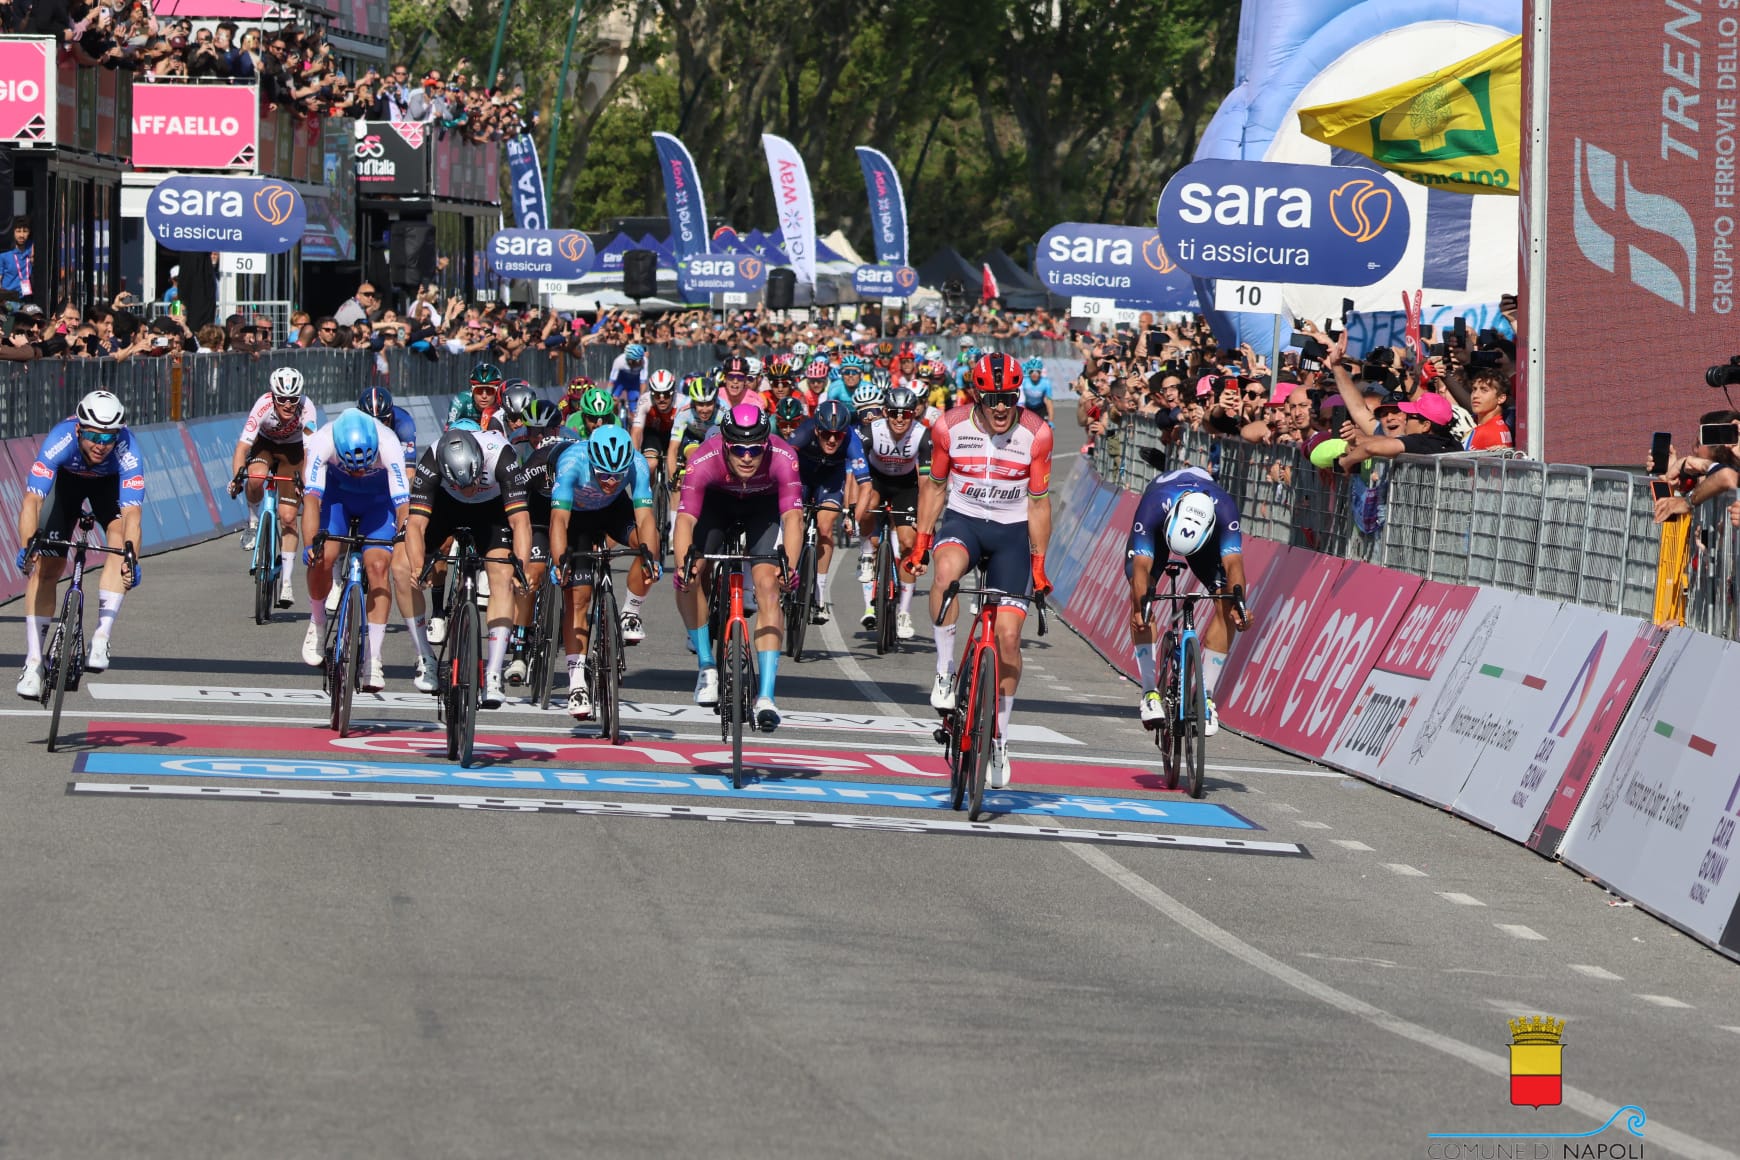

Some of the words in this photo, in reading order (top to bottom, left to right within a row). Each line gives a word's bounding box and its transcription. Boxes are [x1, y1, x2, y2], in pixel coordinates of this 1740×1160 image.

[1716, 17, 1739, 91] DELLO
[1714, 98, 1737, 209] FERROVIE
[670, 159, 685, 189] way
[778, 159, 798, 205] way
[158, 188, 243, 218] sara
[1178, 182, 1312, 228] sara
[158, 223, 170, 238] ti
[173, 224, 243, 241] assicura
[676, 206, 693, 242] enel
[495, 235, 553, 257] sara
[1048, 234, 1133, 266] sara
[1177, 238, 1194, 261] ti
[1201, 240, 1310, 266] assicura
[235, 258, 253, 270] 50
[495, 259, 503, 270] ti
[505, 260, 552, 272] assicura
[690, 260, 735, 276] sara
[856, 269, 894, 283] sara
[1712, 215, 1735, 315] GRUPPO
[545, 282, 563, 292] 100
[1048, 269, 1060, 284] ti
[1062, 271, 1131, 288] assicura
[1083, 302, 1100, 314] 50
[1235, 285, 1262, 306] 10
[693, 449, 719, 465] CASTELLI
[879, 444, 912, 458] UAE
[954, 463, 1027, 477] TREK
[1279, 586, 1404, 739] enel
[1344, 691, 1407, 758] TUDOR
[328, 735, 949, 778] enel
